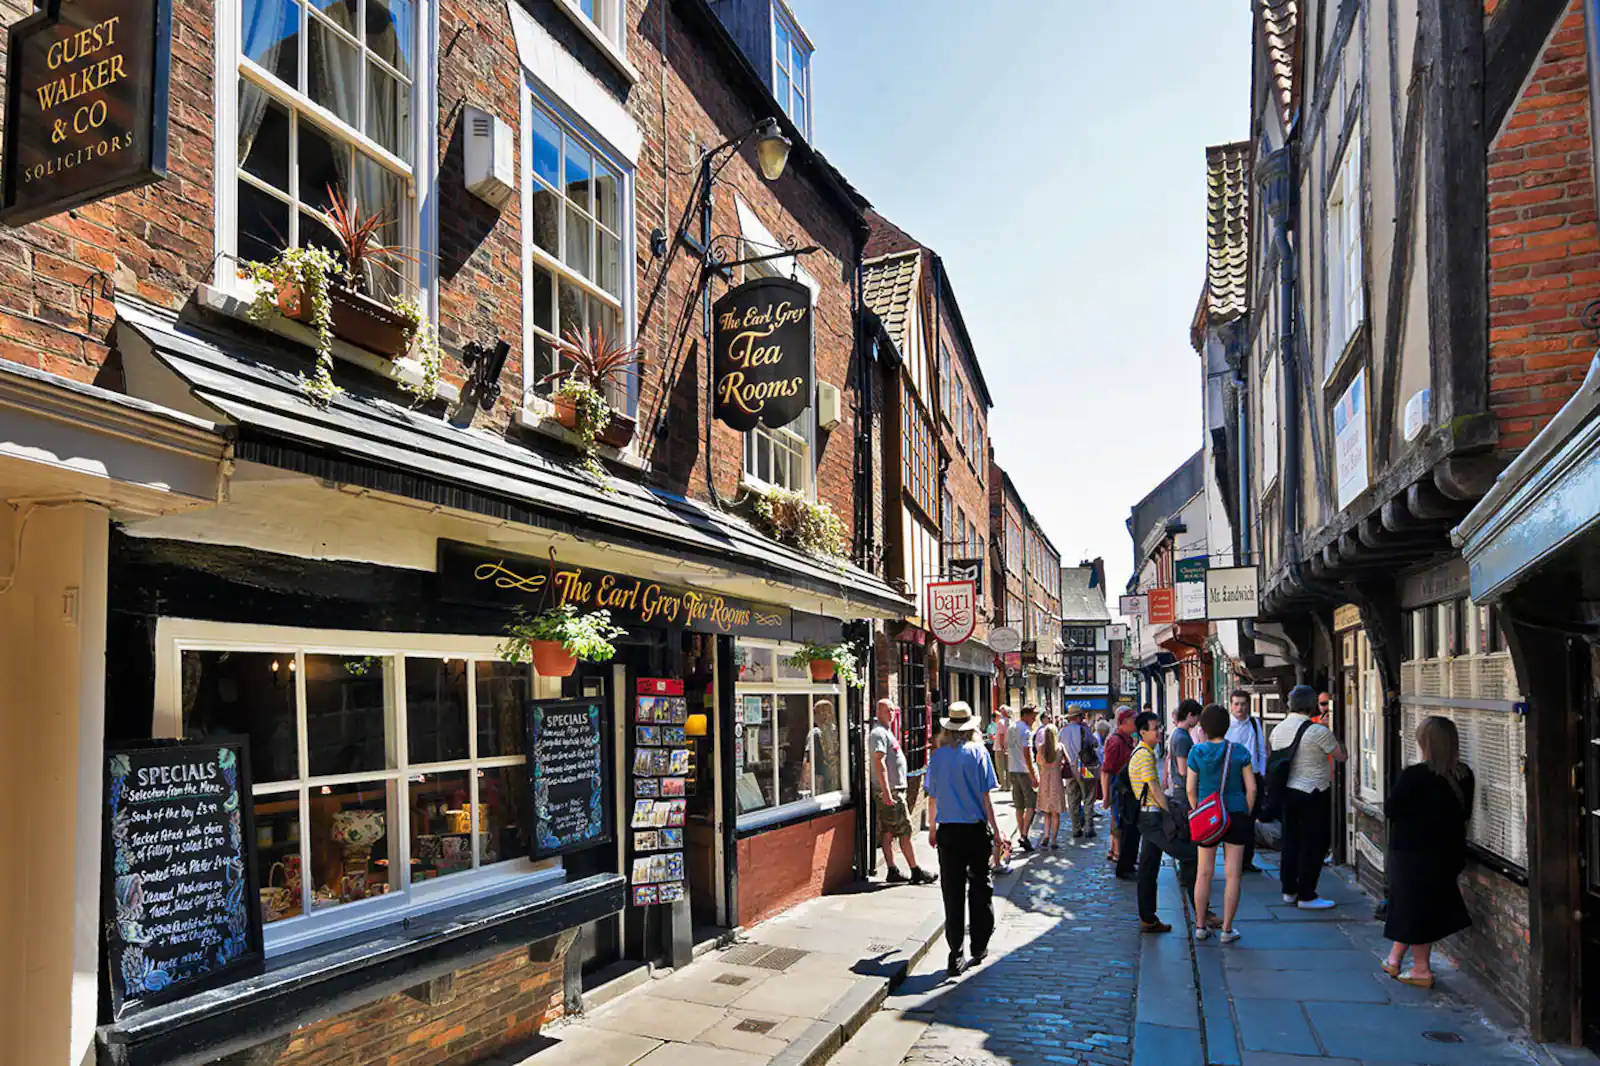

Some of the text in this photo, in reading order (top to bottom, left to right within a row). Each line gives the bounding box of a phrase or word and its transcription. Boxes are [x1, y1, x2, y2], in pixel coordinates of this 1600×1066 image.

[47, 16, 120, 70] GUEST
[36, 54, 128, 112] WALKER
[51, 99, 108, 144] & CO
[24, 131, 134, 183] SOLICITORS
[719, 301, 808, 330] The Earl Grey
[728, 323, 784, 369] Tea
[718, 371, 804, 413] Rooms
[555, 568, 751, 632] The Earl Grey Tea Rooms
[934, 590, 970, 611] bari
[547, 713, 588, 728] SPECIALS
[138, 762, 217, 786] SPECIALS
[129, 787, 166, 801] Selection
[165, 784, 184, 798] from
[184, 783, 197, 795] the
[131, 809, 153, 824] Soup
[153, 807, 164, 822] of
[165, 807, 179, 819] the
[131, 830, 159, 847] Jacket
[137, 845, 146, 862] of
